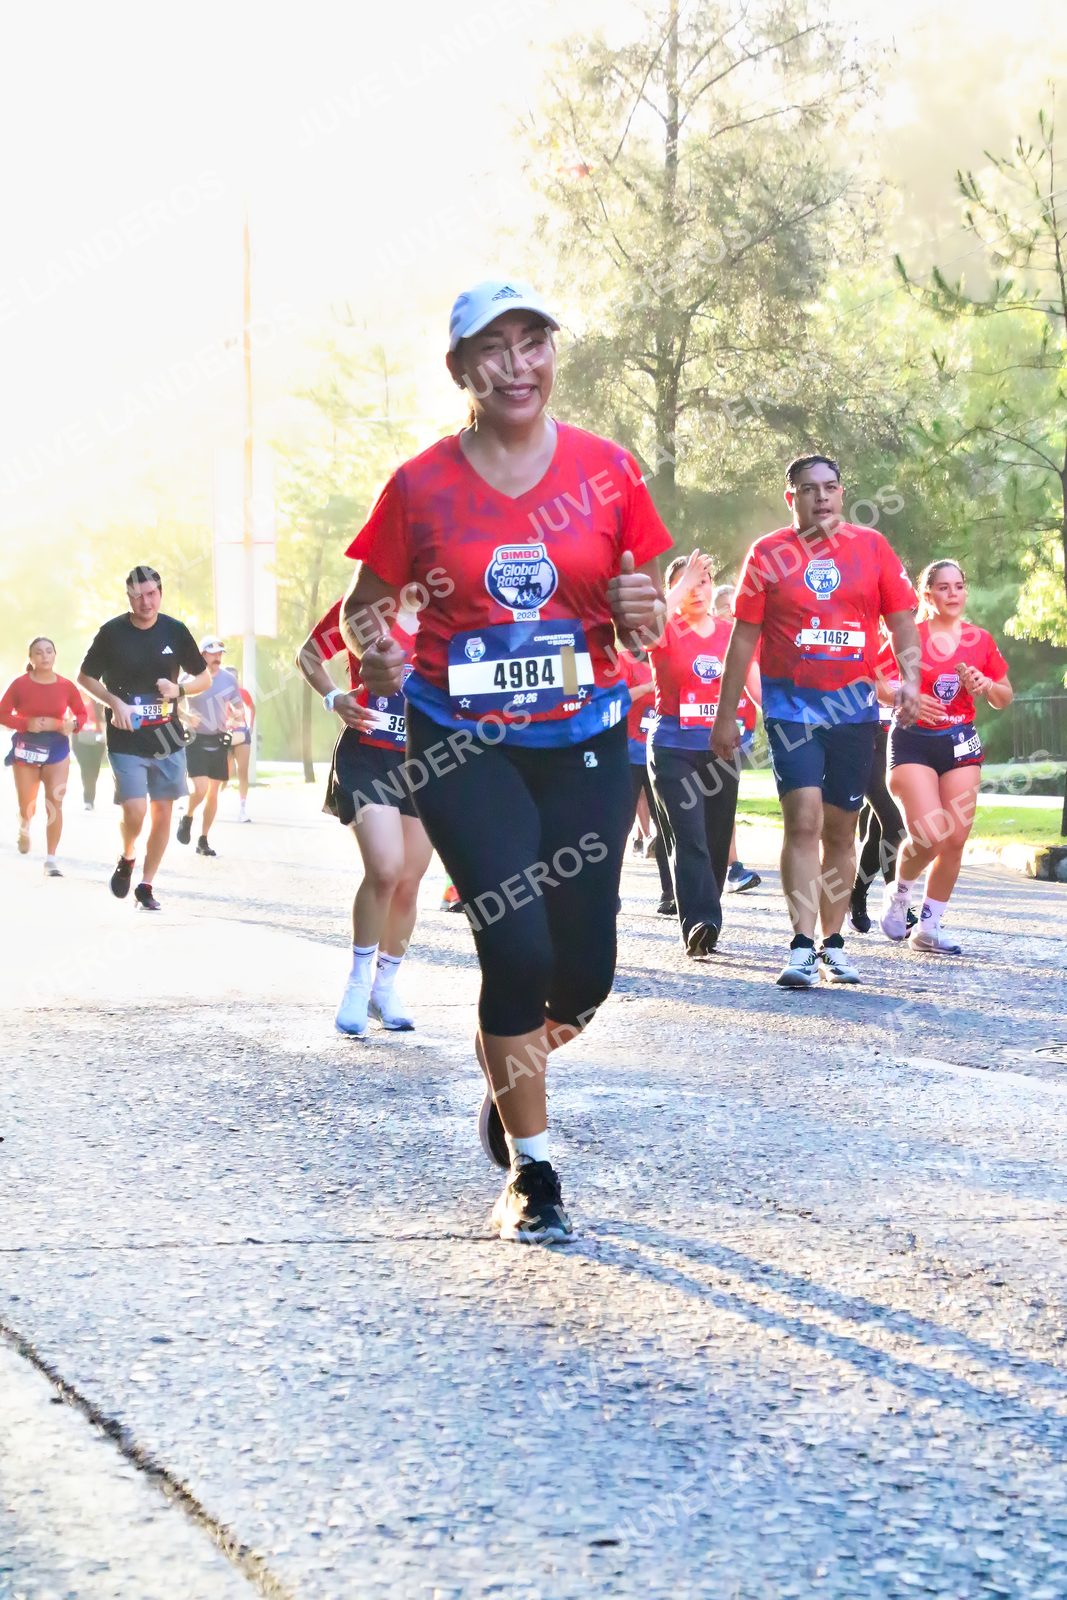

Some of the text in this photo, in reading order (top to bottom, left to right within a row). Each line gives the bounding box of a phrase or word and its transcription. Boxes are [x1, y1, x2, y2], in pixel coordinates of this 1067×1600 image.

[501, 550, 540, 560] BIMBO
[503, 564, 540, 577] Global
[497, 575, 527, 588] Race
[516, 611, 537, 620] 2026
[823, 630, 849, 645] 1462
[494, 658, 555, 690] 4984
[143, 705, 162, 714] 5295
[699, 704, 718, 716] 146
